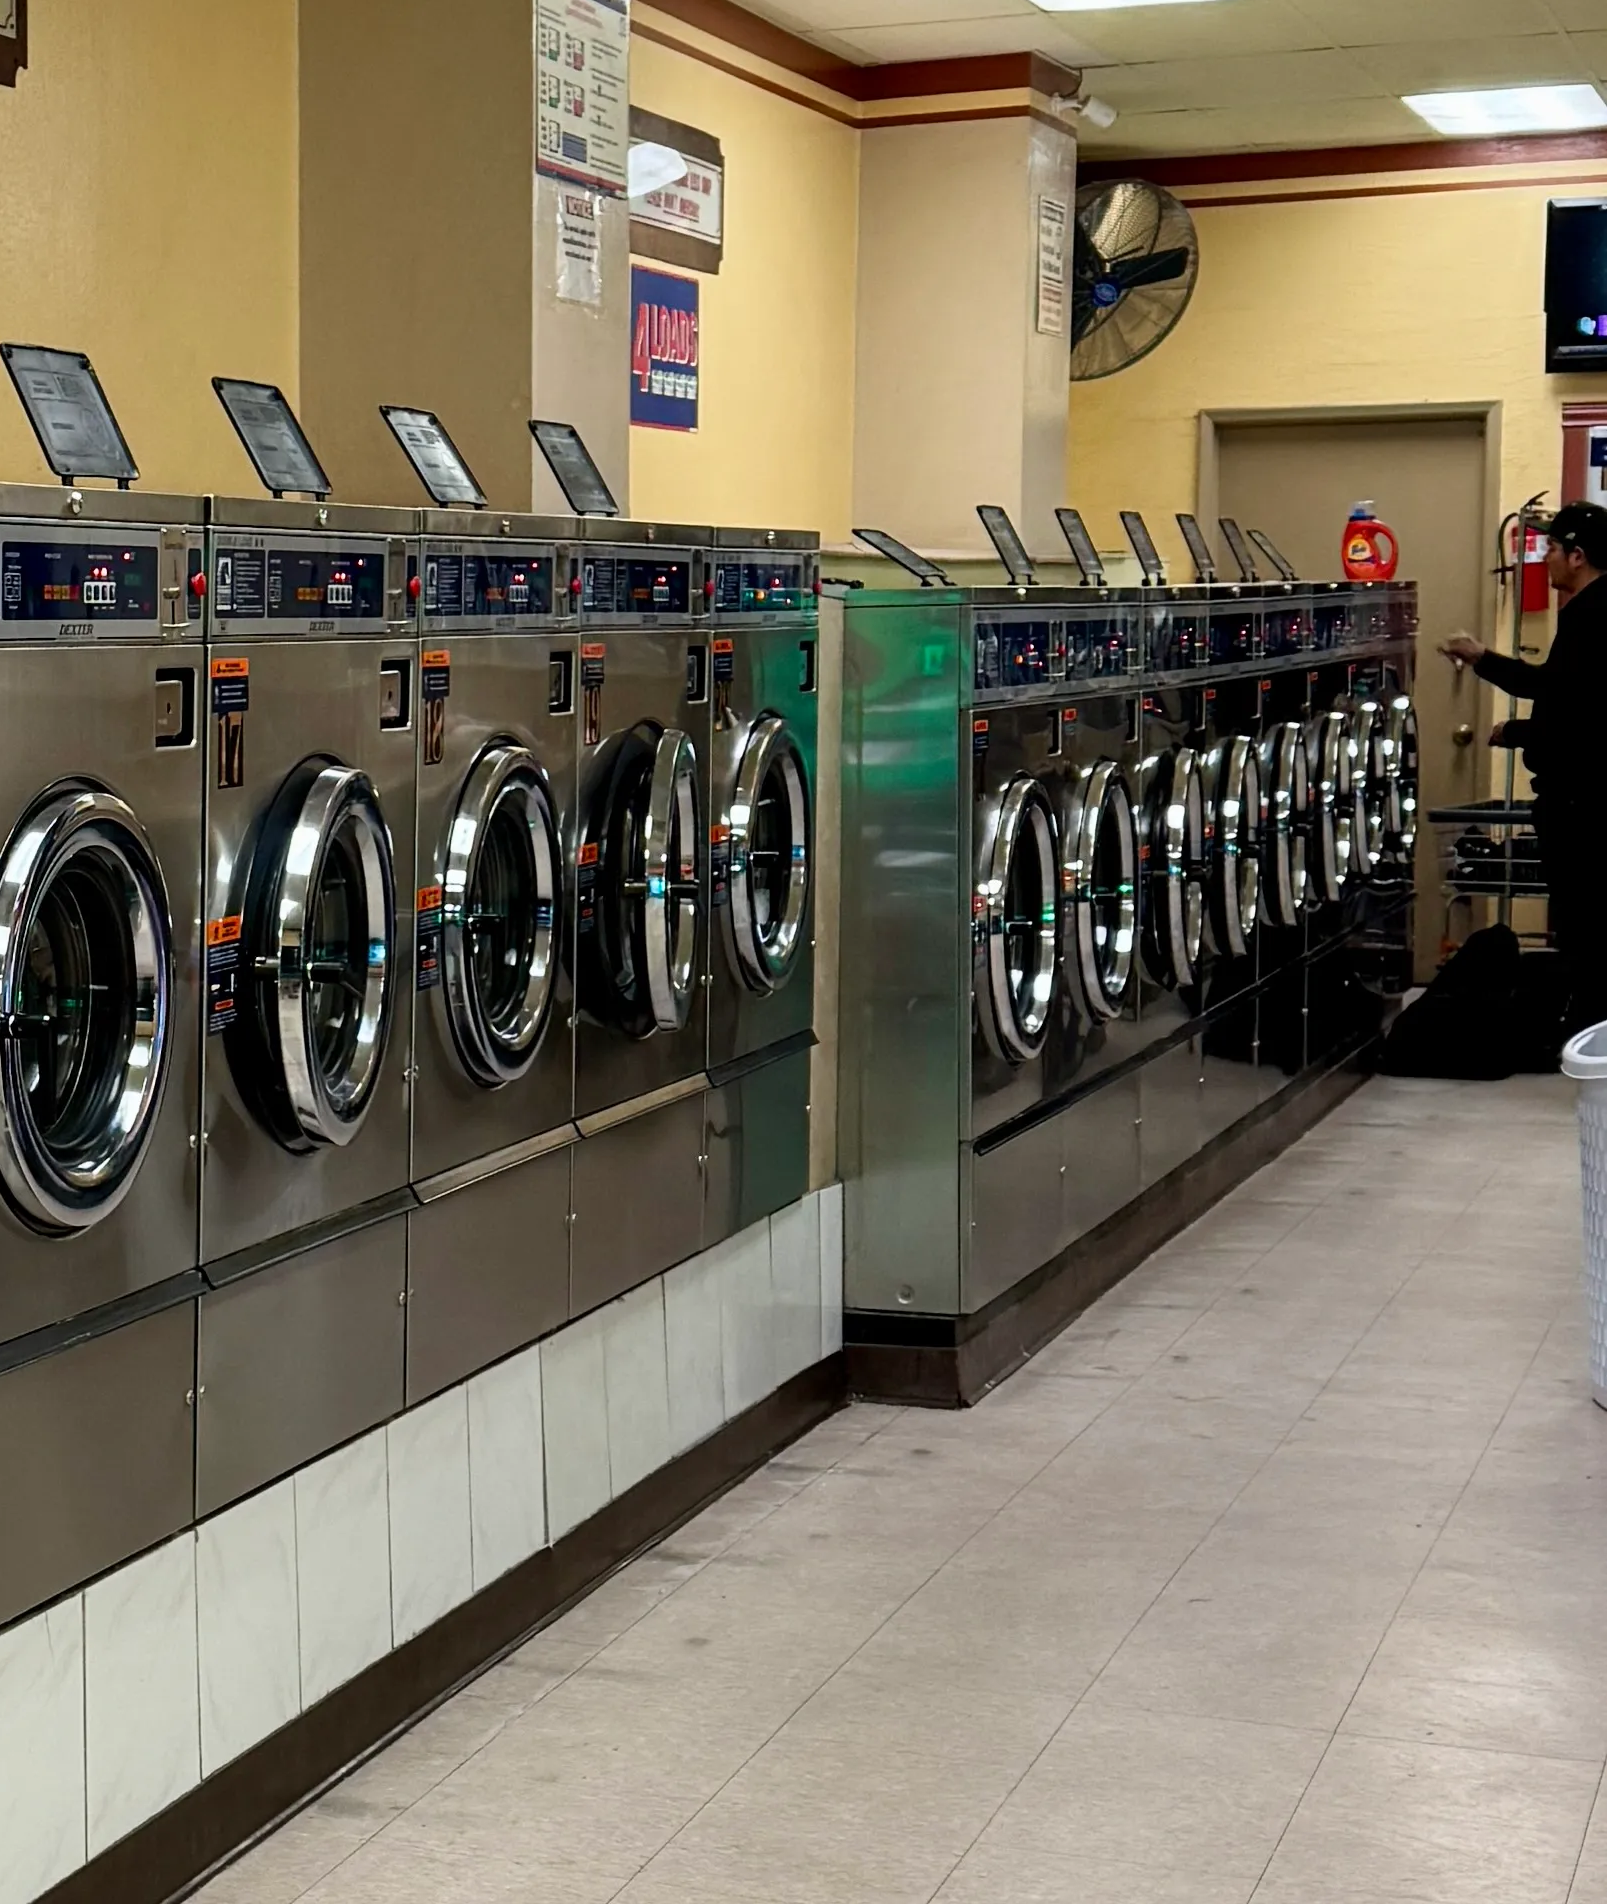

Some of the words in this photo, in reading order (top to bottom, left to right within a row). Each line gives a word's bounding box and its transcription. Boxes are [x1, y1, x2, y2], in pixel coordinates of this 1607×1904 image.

[633, 302, 650, 392] 4
[650, 304, 698, 367] LOADS
[59, 623, 94, 635] DEXTER
[219, 711, 242, 787] 17
[426, 698, 444, 764] 18
